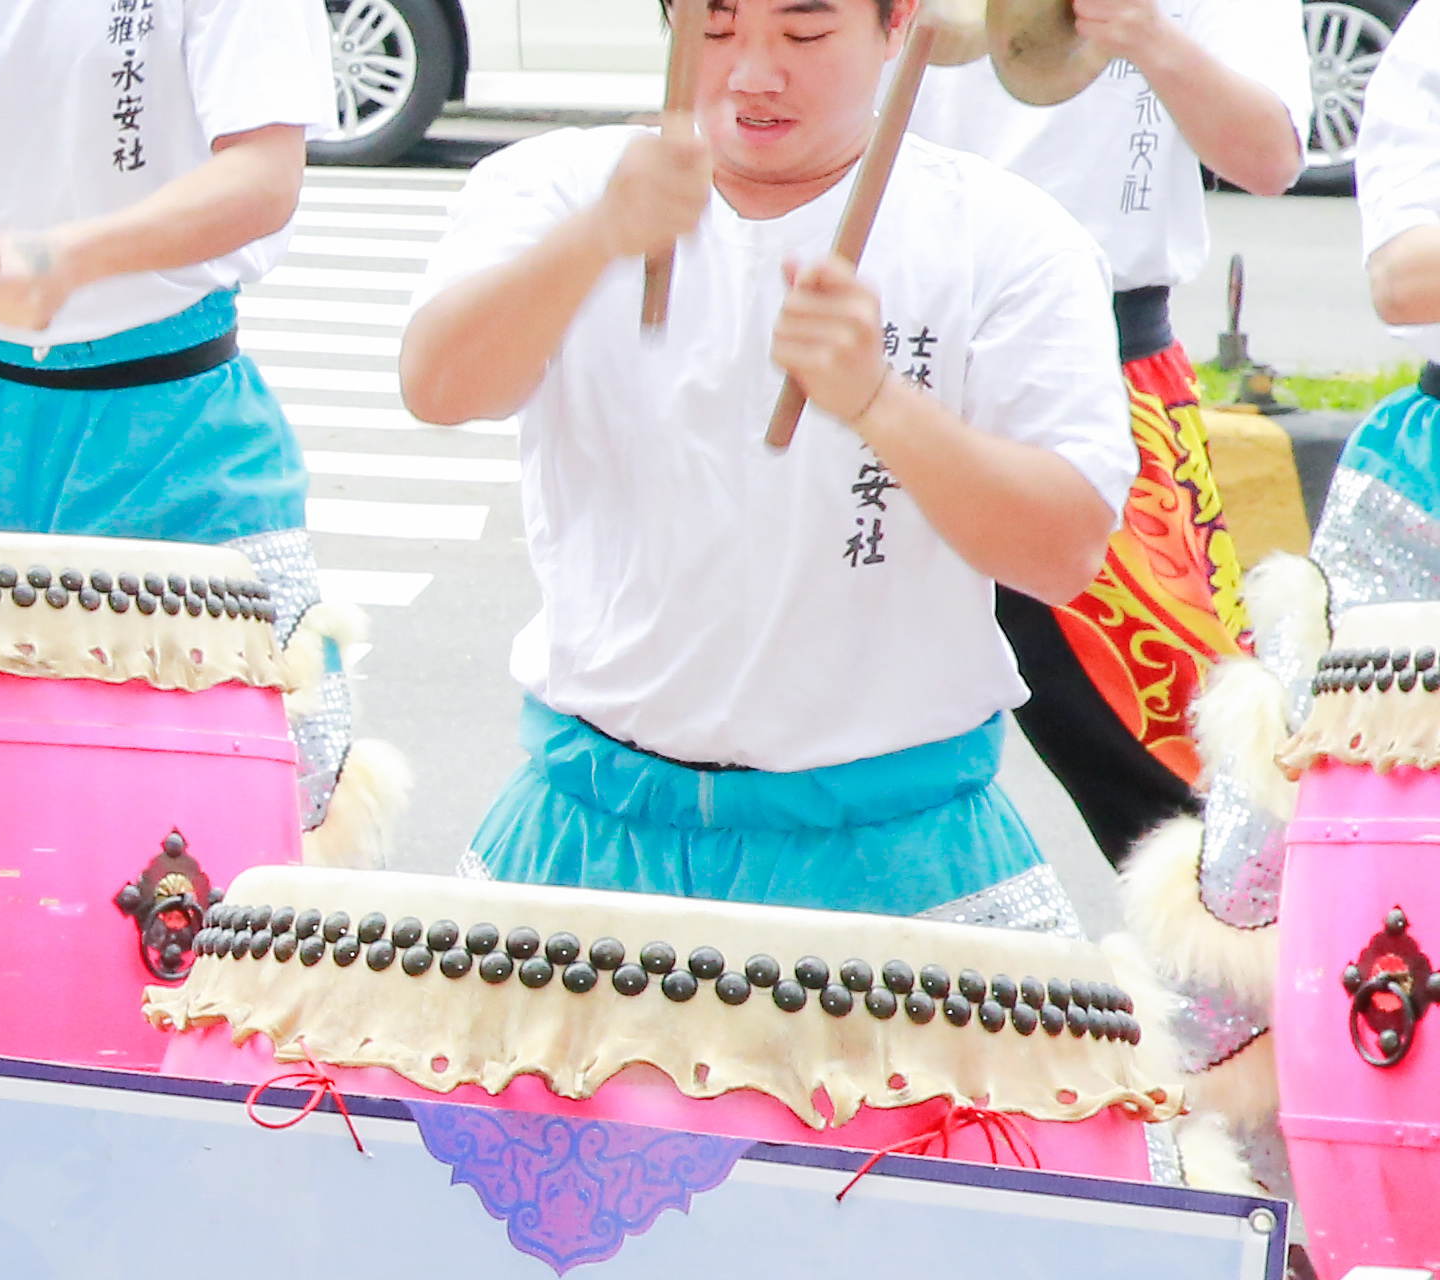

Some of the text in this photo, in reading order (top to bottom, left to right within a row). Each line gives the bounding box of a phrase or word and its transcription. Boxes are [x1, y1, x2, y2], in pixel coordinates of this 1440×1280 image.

[110, 48, 148, 174] 永安社
[842, 440, 902, 568] 安社
